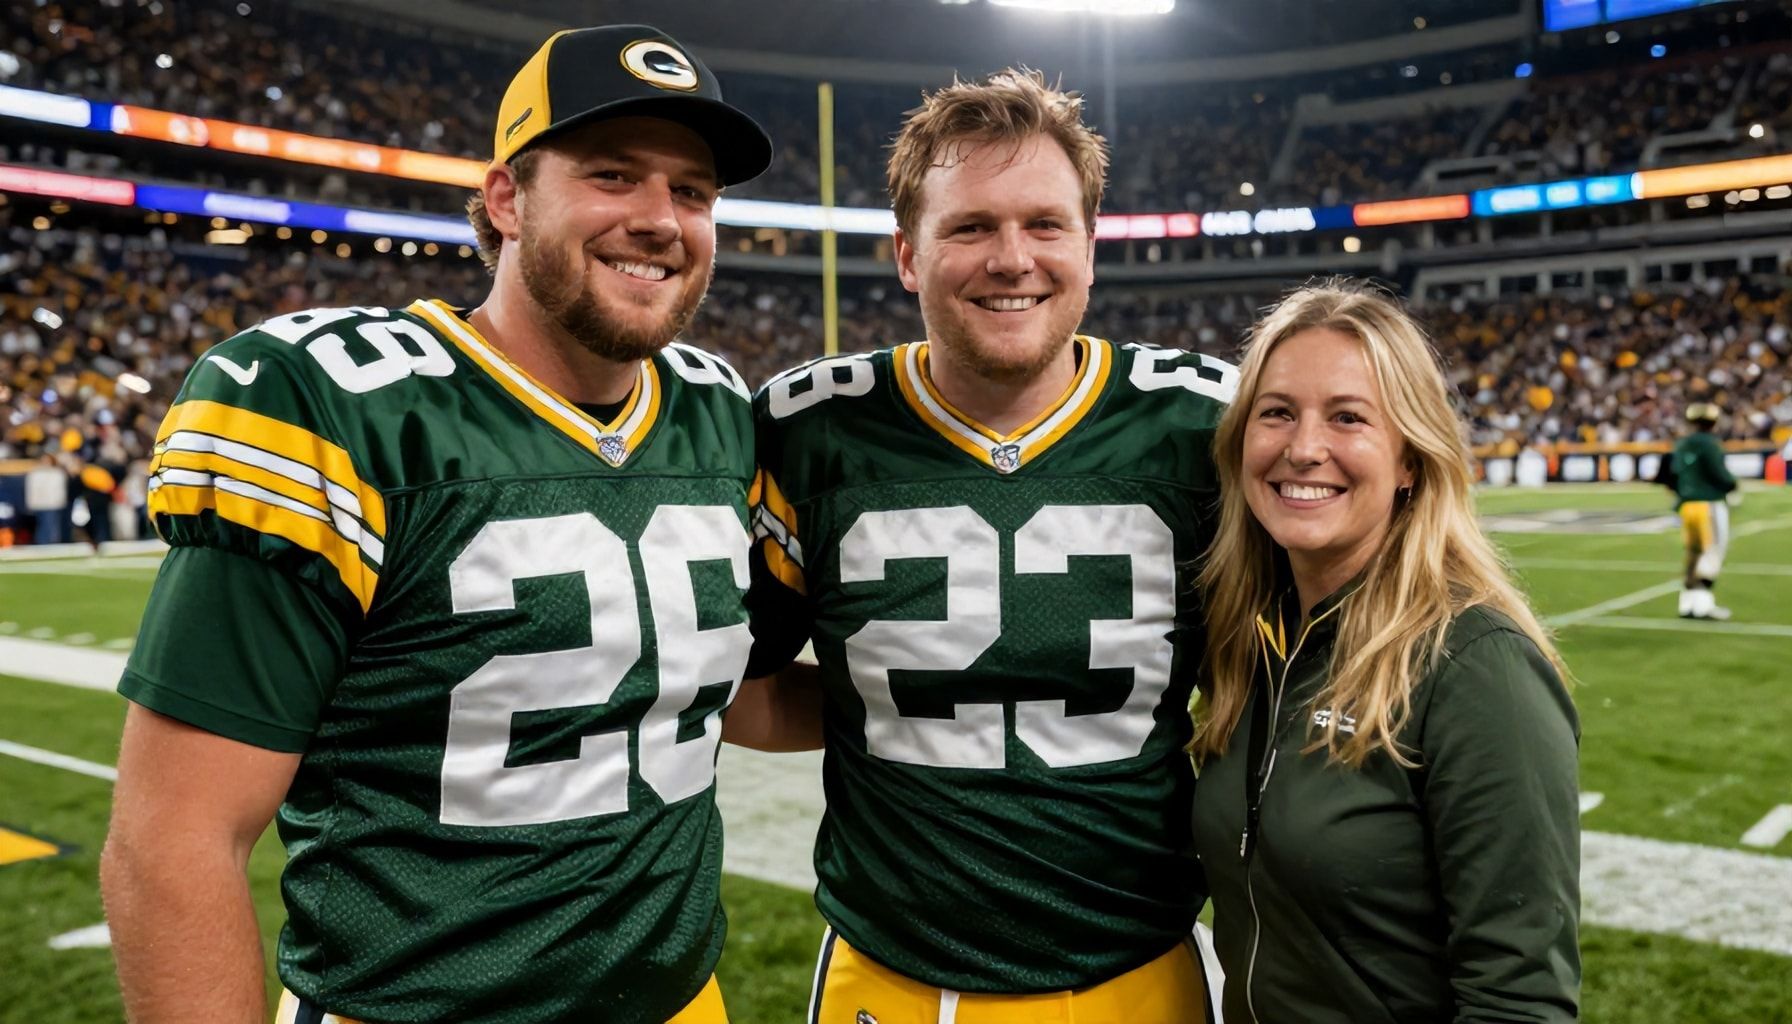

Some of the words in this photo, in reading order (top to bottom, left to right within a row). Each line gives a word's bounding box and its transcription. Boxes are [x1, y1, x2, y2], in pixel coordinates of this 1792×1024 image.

[621, 38, 699, 93] G
[439, 505, 755, 827] 26
[840, 504, 1176, 769] 23
